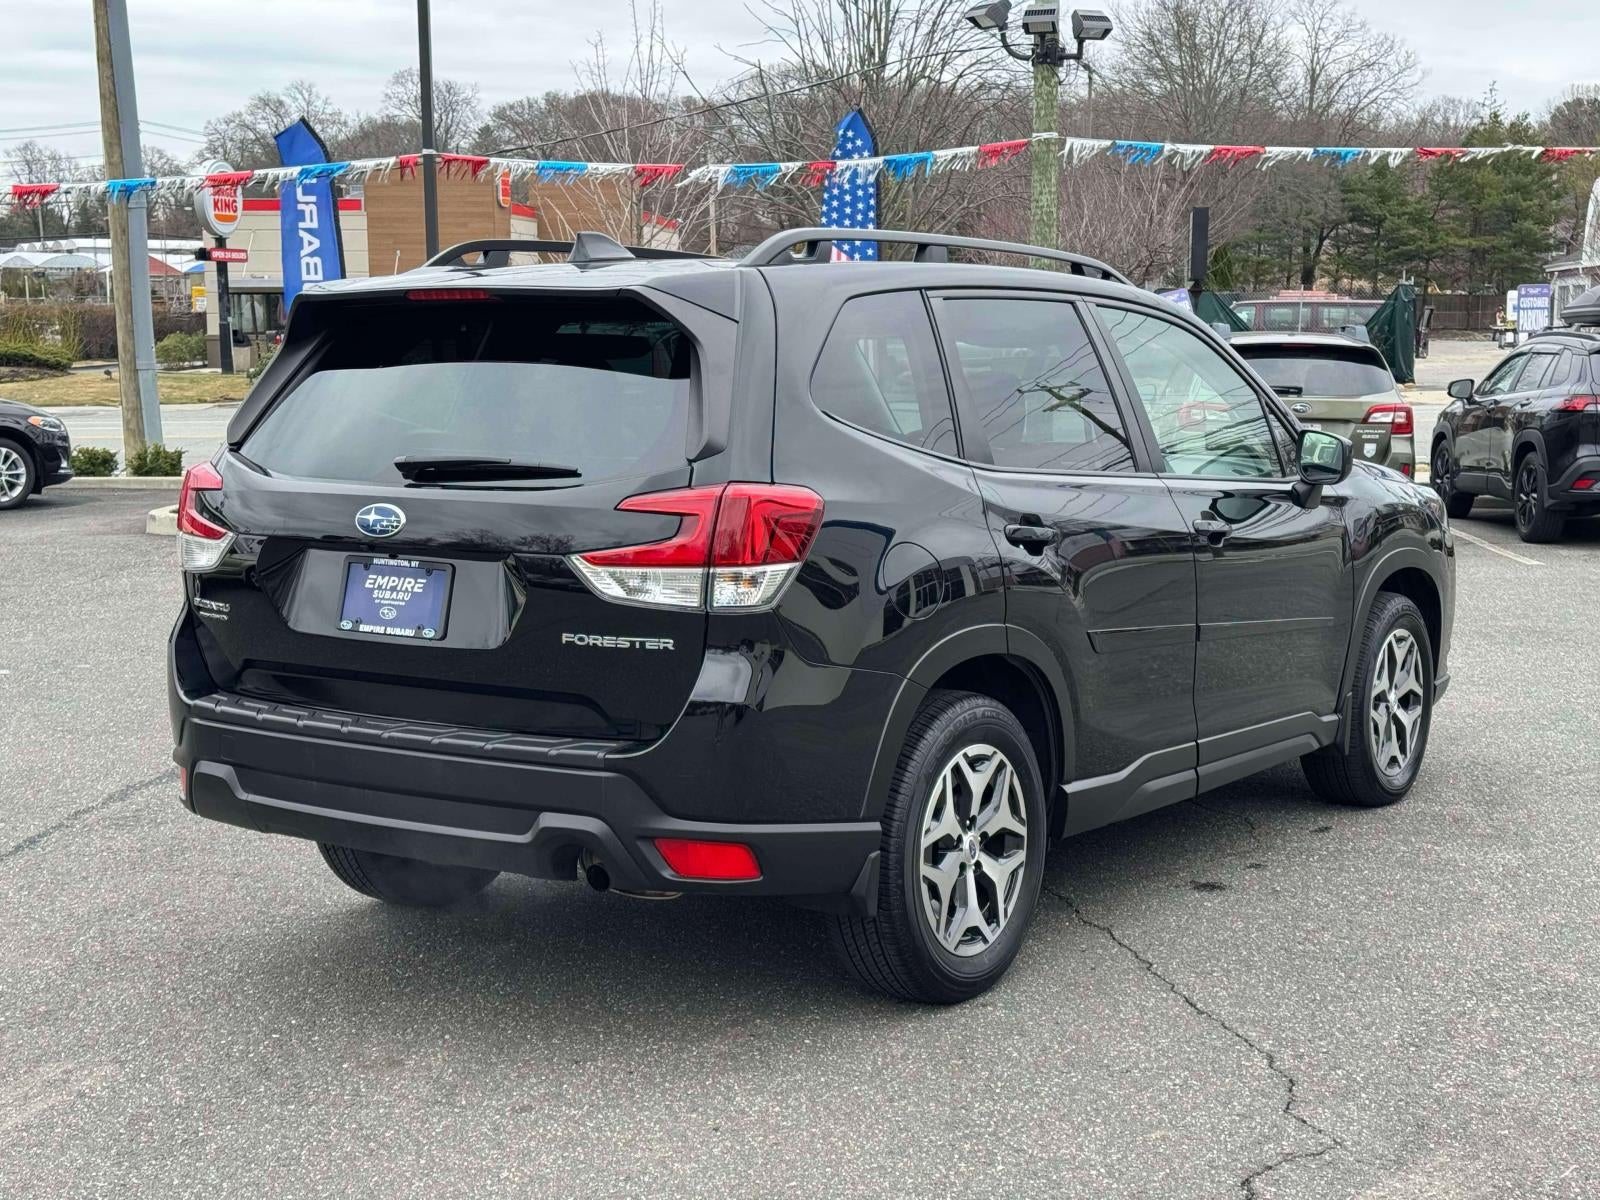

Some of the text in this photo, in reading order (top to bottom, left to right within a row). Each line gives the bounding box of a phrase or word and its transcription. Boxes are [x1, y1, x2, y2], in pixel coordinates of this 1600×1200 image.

[213, 198, 238, 213] KING
[1520, 297, 1549, 308] CUSTOMER
[1519, 309, 1549, 331] PARKING
[364, 574, 427, 592] EMPIRE
[372, 589, 411, 601] SUBARU
[359, 624, 415, 636] EMPIRE SUBARU
[561, 632, 675, 651] FORESTER
